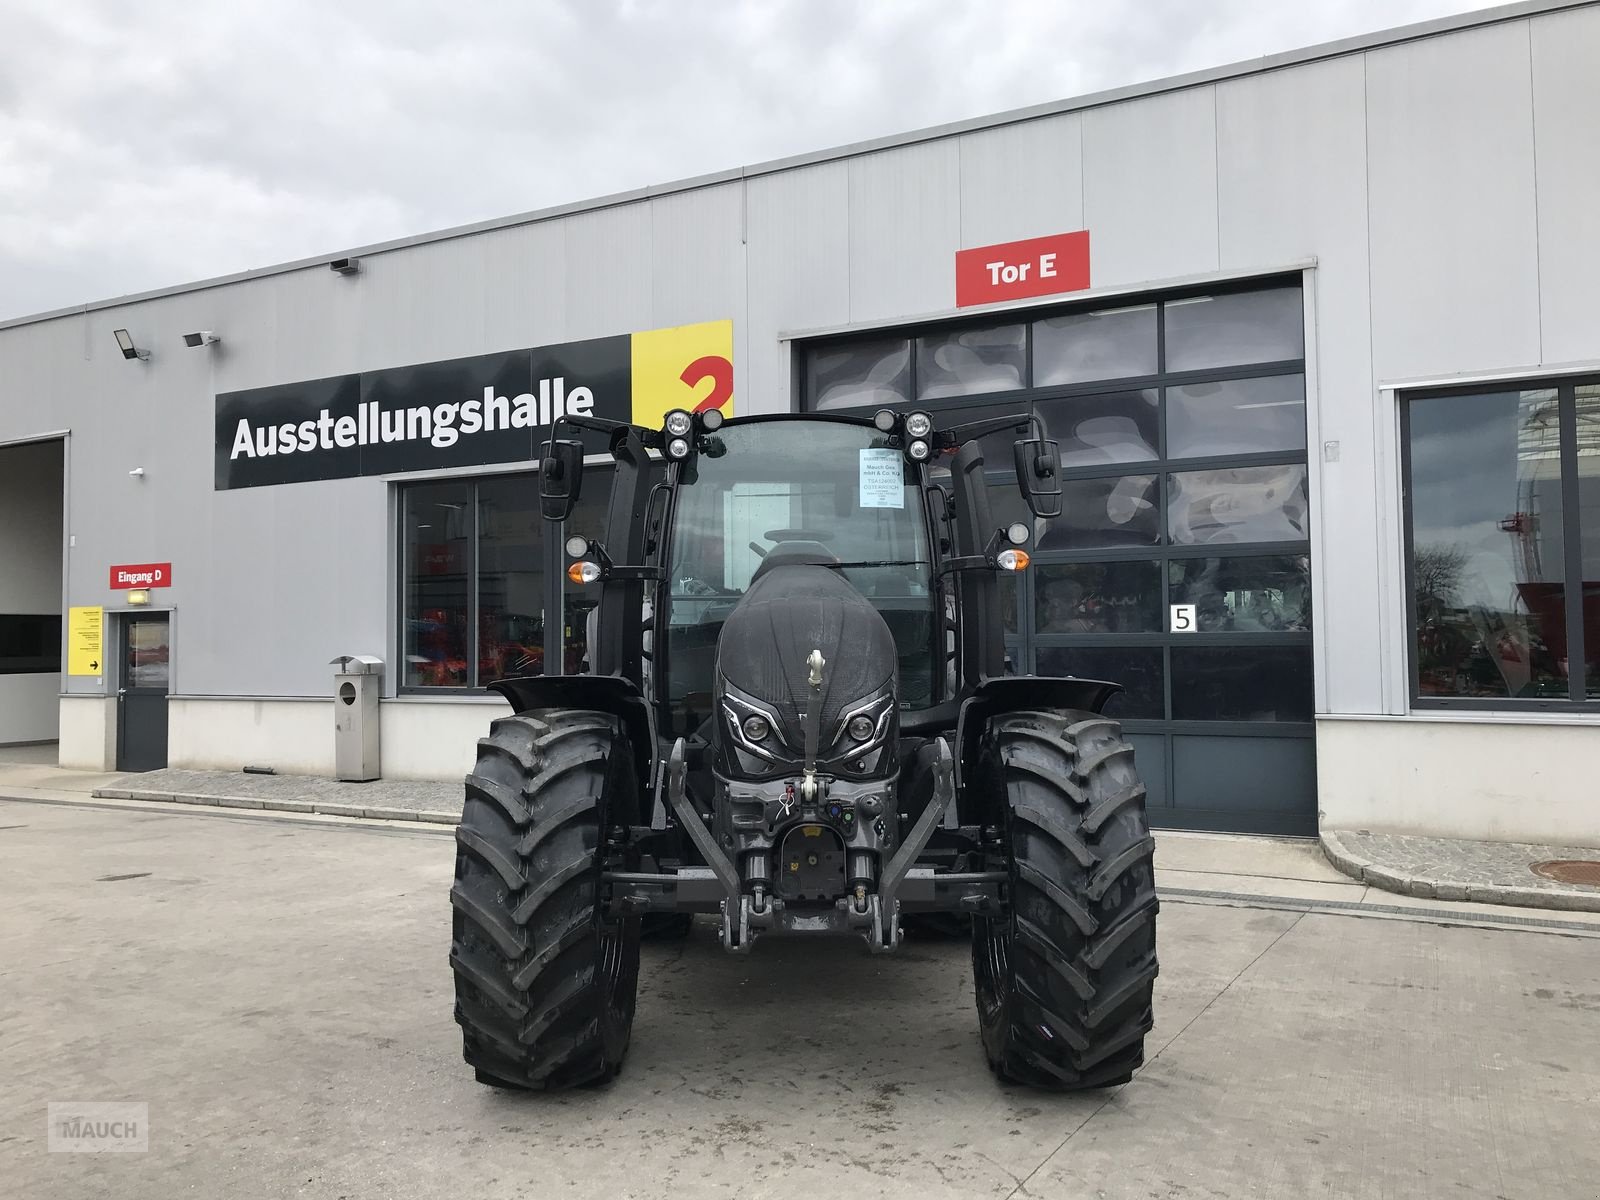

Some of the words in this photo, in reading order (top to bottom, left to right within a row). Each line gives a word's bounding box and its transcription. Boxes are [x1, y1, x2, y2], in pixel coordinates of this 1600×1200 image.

[986, 261, 1031, 286] Tor
[1040, 252, 1057, 278] E
[230, 376, 595, 460] Ausstellungshalle
[679, 355, 734, 414] 2
[118, 571, 153, 585] Eingang
[154, 569, 162, 581] D
[1176, 608, 1190, 630] 5
